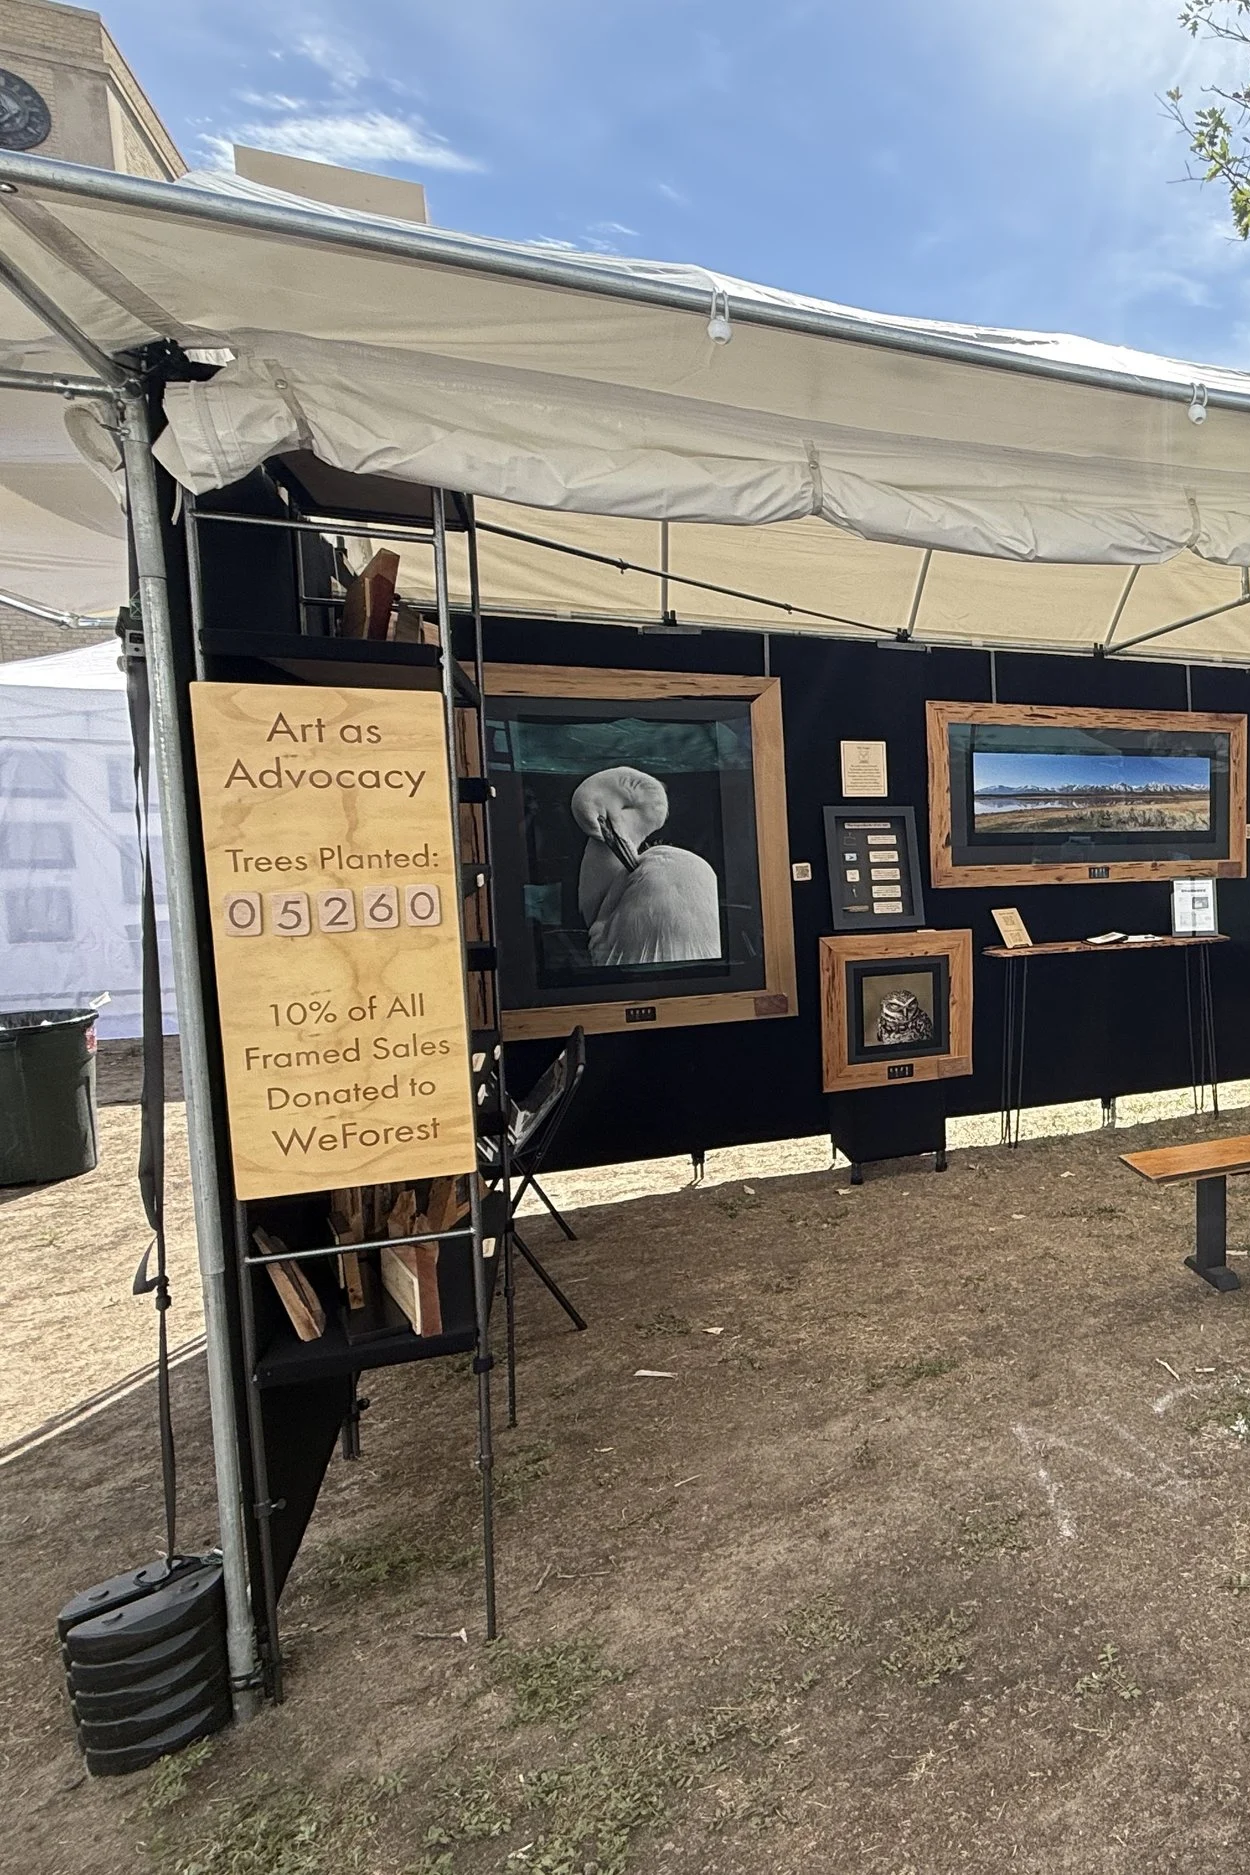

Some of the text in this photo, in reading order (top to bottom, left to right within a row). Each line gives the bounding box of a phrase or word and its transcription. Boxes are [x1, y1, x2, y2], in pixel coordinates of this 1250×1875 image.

[266, 712, 382, 745] Art as
[224, 757, 426, 797] Advocacy
[225, 843, 439, 873] Trees Planted:
[269, 993, 425, 1027] 10% of All
[245, 1032, 450, 1071] Framed Sales
[266, 1075, 436, 1111] Donated to
[272, 1117, 441, 1156] WeForest
